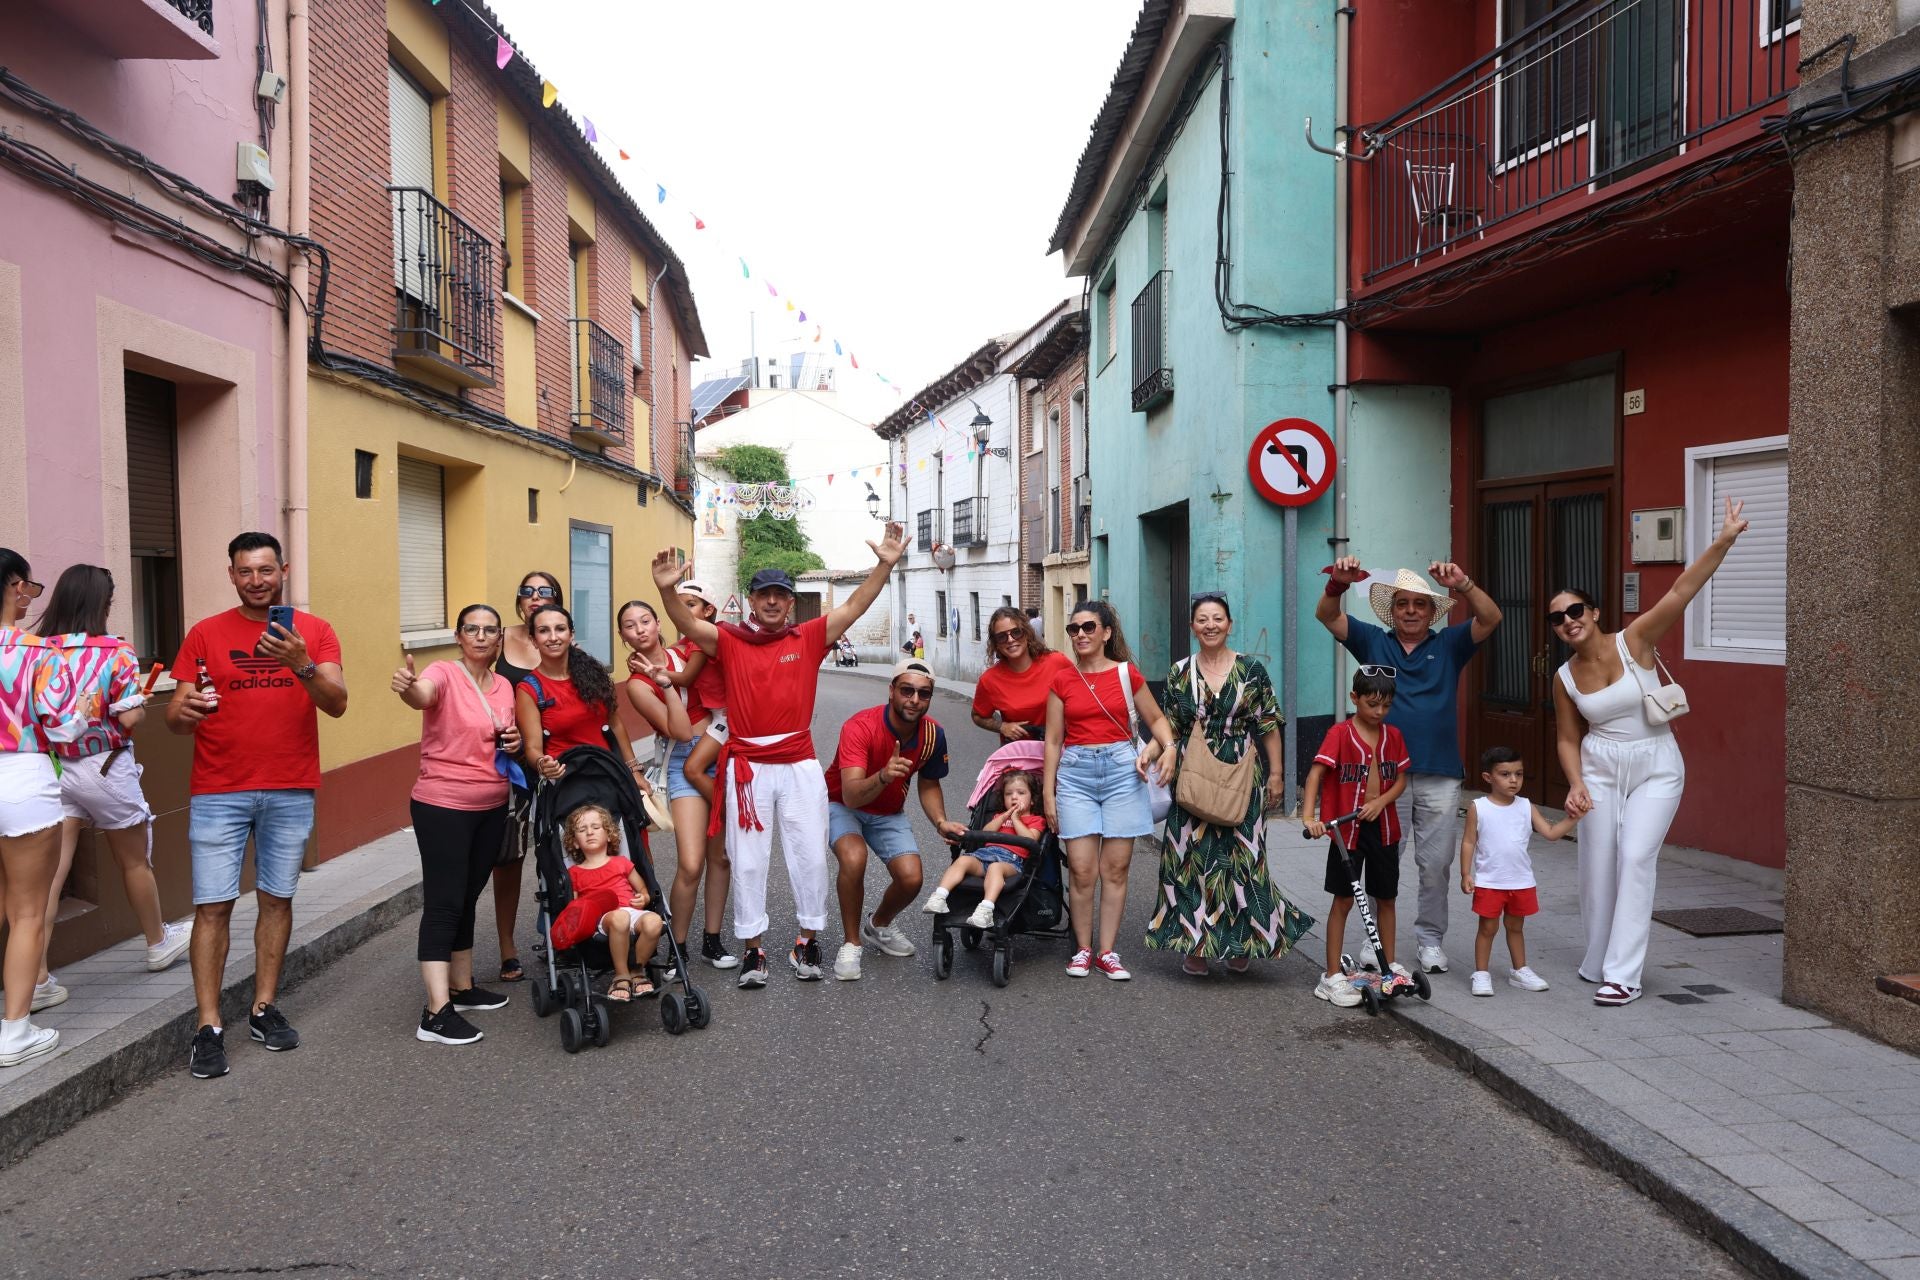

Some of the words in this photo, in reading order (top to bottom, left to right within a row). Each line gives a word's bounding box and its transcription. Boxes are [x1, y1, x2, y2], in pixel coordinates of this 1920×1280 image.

[1629, 395, 1640, 410] 56
[229, 676, 295, 691] adidas
[1350, 880, 1383, 951] KINSKATE
